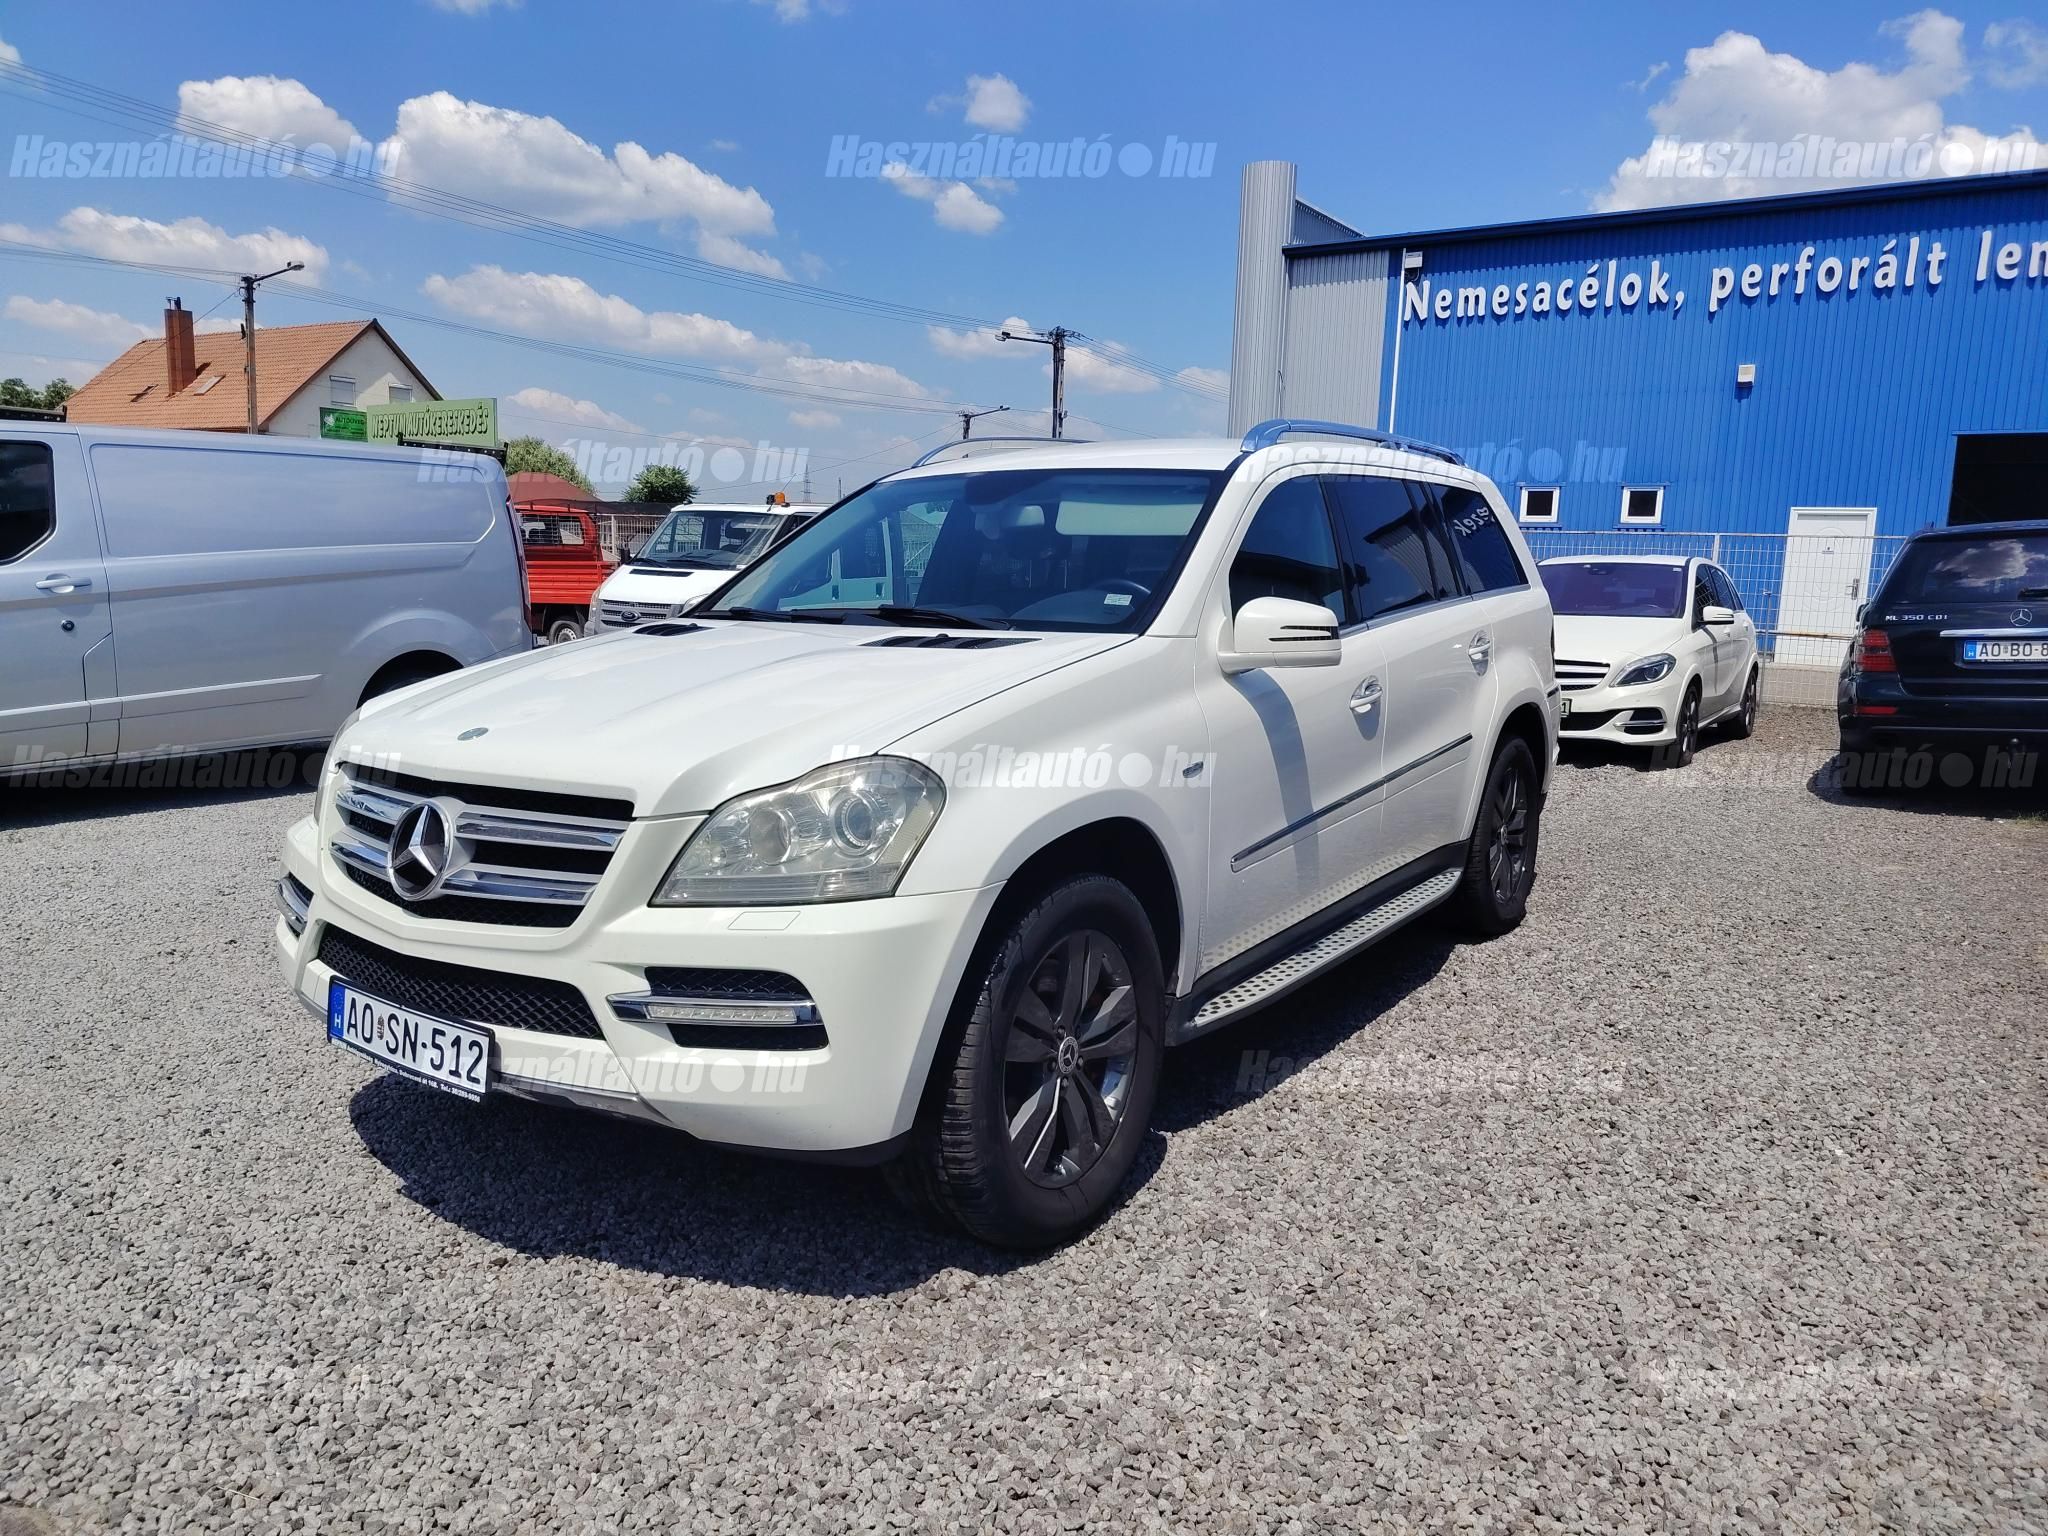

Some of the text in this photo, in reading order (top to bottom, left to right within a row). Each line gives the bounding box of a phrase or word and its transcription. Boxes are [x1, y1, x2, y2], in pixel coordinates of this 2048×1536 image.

[1403, 260, 1685, 321] Nemesacélok,
[1709, 236, 1947, 312] perforált
[372, 413, 406, 438] NEPTUN
[408, 402, 489, 437] AUTÓKERESKEDÉS
[333, 1013, 342, 1029] H
